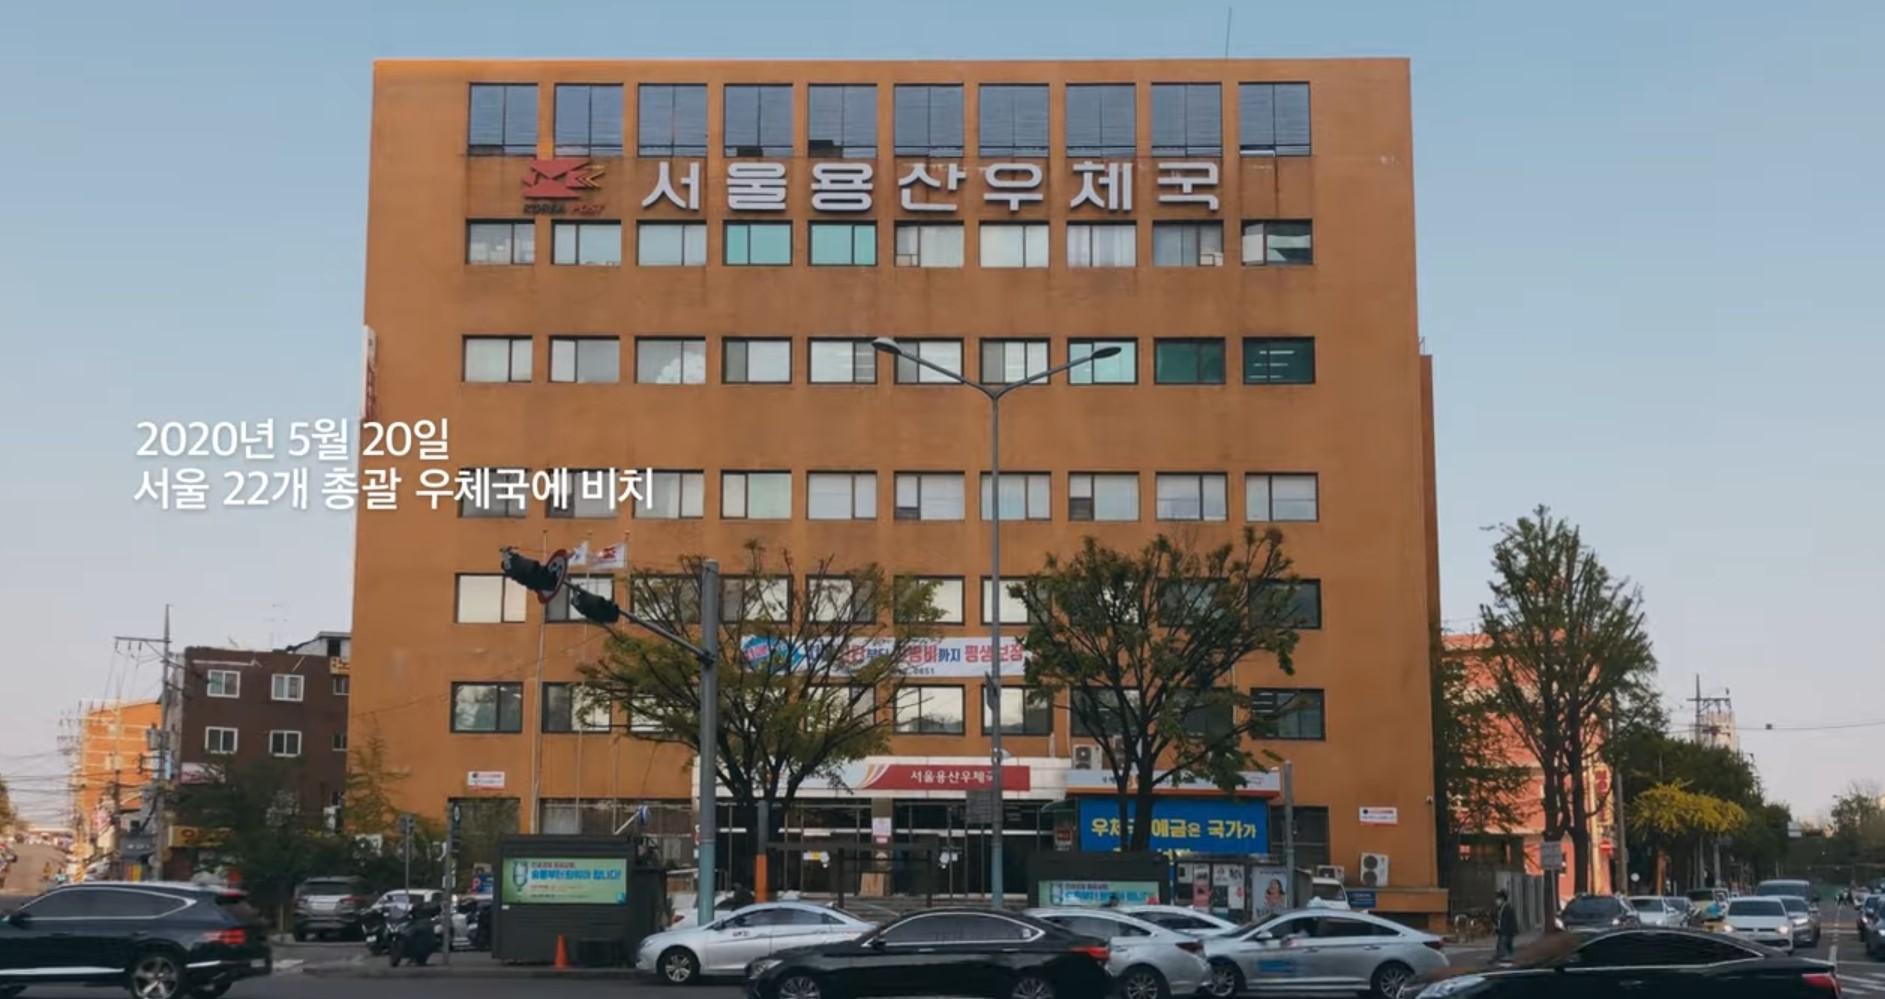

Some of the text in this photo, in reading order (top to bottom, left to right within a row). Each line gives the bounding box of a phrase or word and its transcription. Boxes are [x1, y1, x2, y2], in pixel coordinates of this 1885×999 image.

[640, 161, 1220, 212] 서울용산우체국
[1151, 818, 1201, 838] 예금은
[1207, 819, 1257, 839] 국가가
